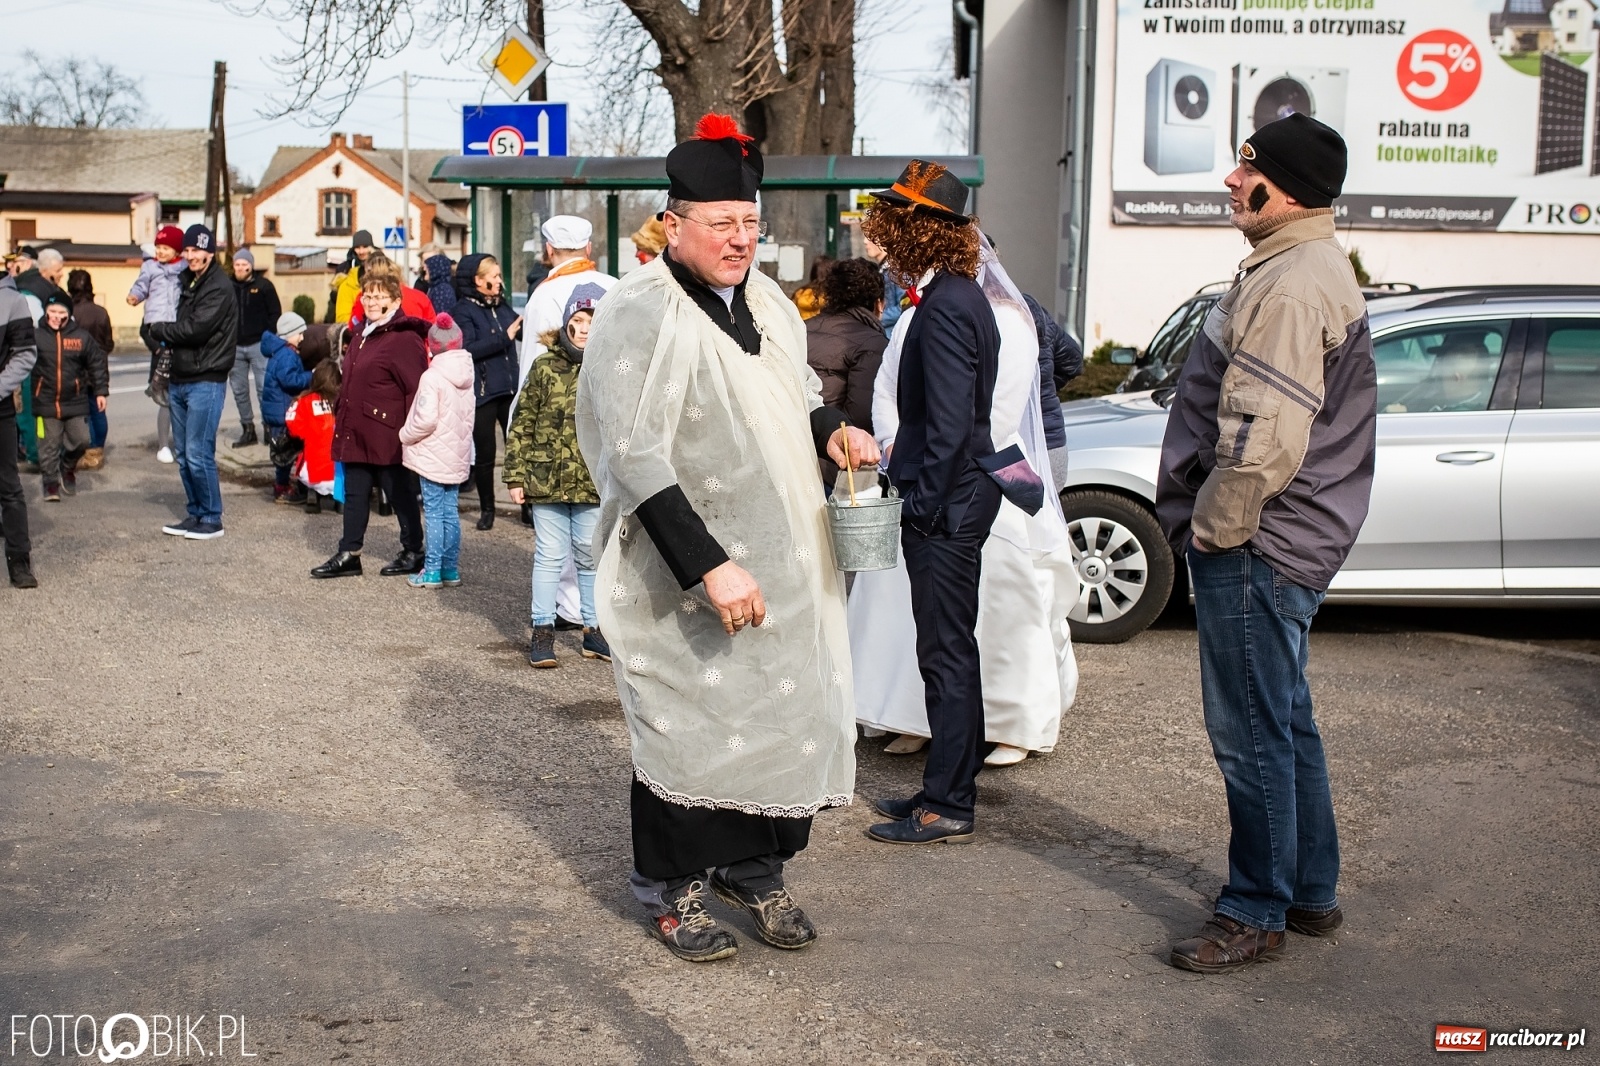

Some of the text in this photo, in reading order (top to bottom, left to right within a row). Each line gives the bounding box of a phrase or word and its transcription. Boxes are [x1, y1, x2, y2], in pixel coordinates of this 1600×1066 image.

[1144, 15, 1406, 36] w Twoim domu, a otrzymasz
[1405, 42, 1477, 100] 5%
[1379, 119, 1470, 138] rabatu na
[1377, 143, 1499, 166] fotowoltaikę
[1125, 201, 1180, 216] Racibórz,
[1182, 202, 1222, 215] Rudzka
[1387, 206, 1495, 223] raciborz2@prosat.pl
